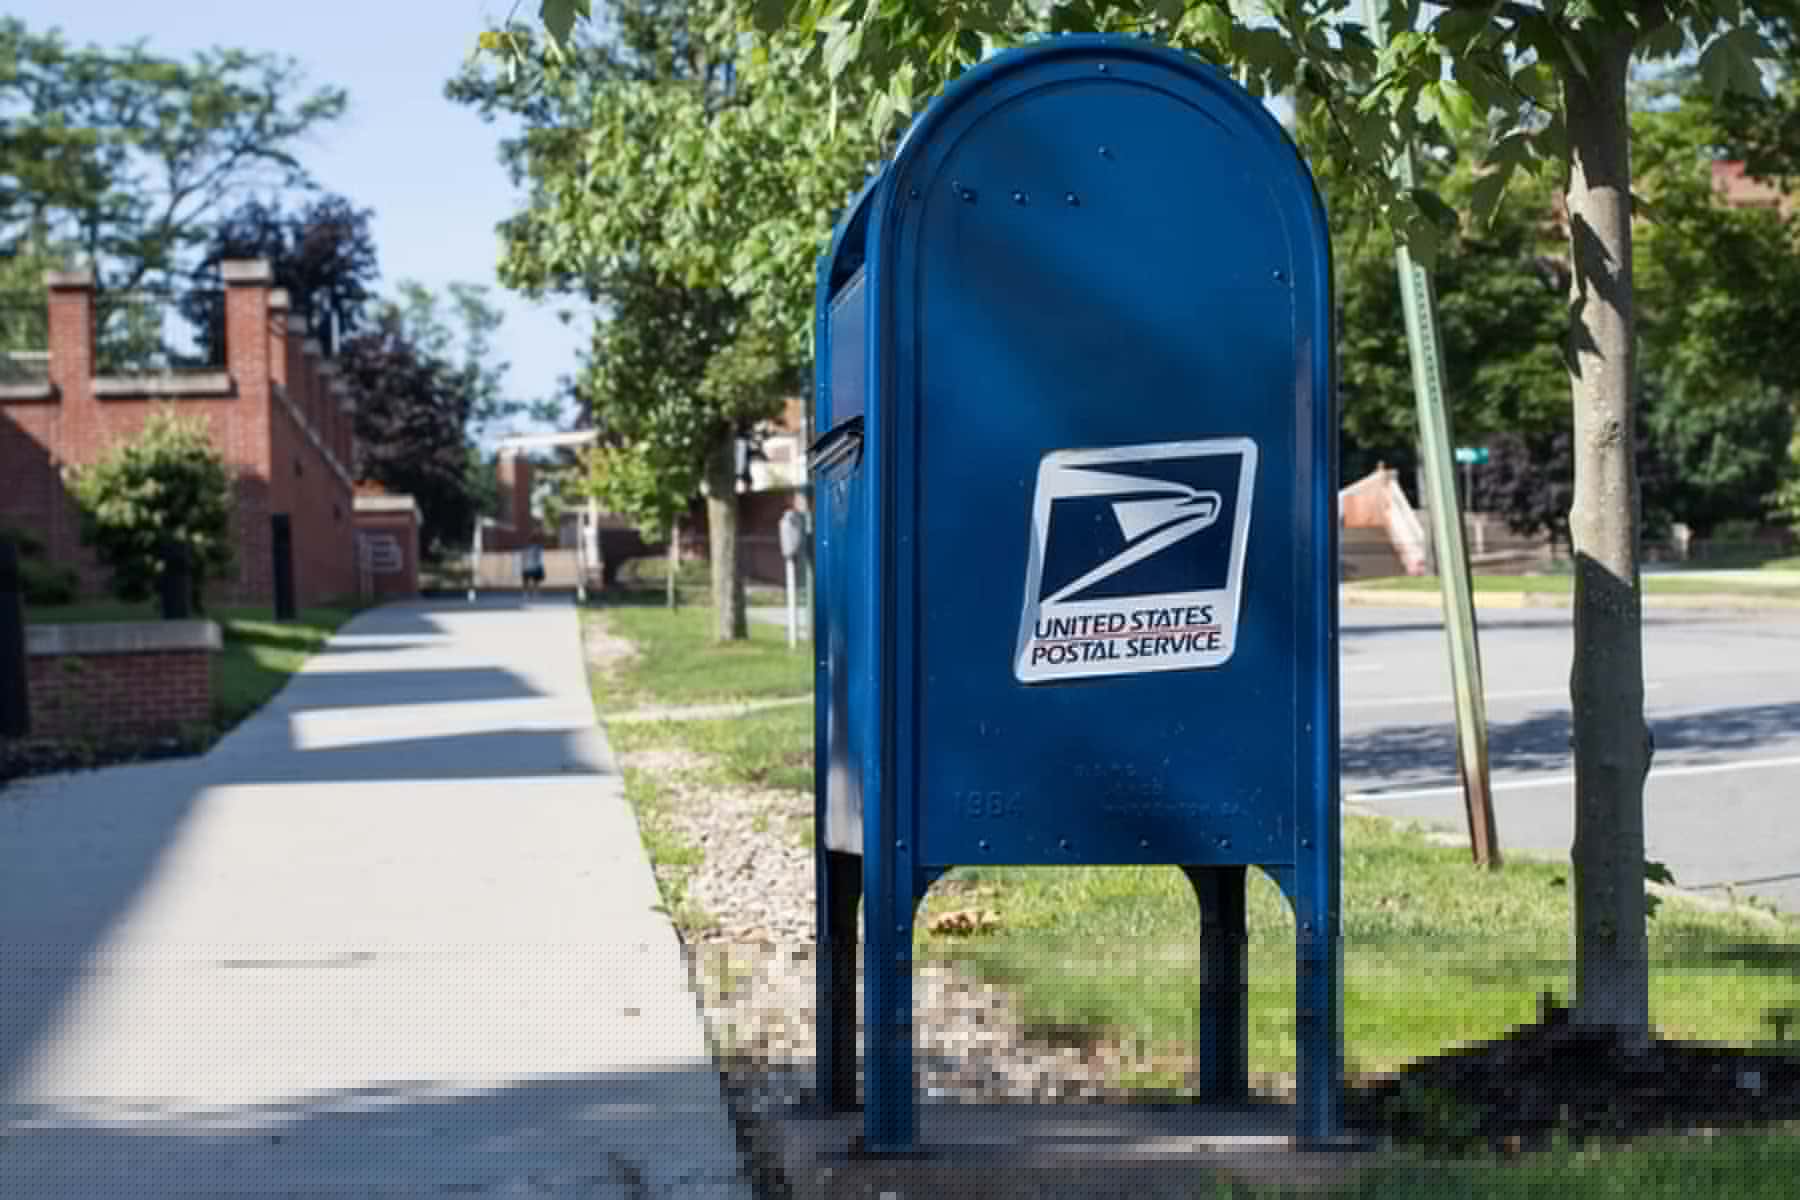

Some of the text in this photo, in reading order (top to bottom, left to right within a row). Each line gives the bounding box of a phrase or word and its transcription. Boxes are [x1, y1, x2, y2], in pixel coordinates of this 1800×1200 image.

[1035, 605, 1213, 639] UNITED STATES
[1031, 632, 1222, 667] POSTAL SERVICE
